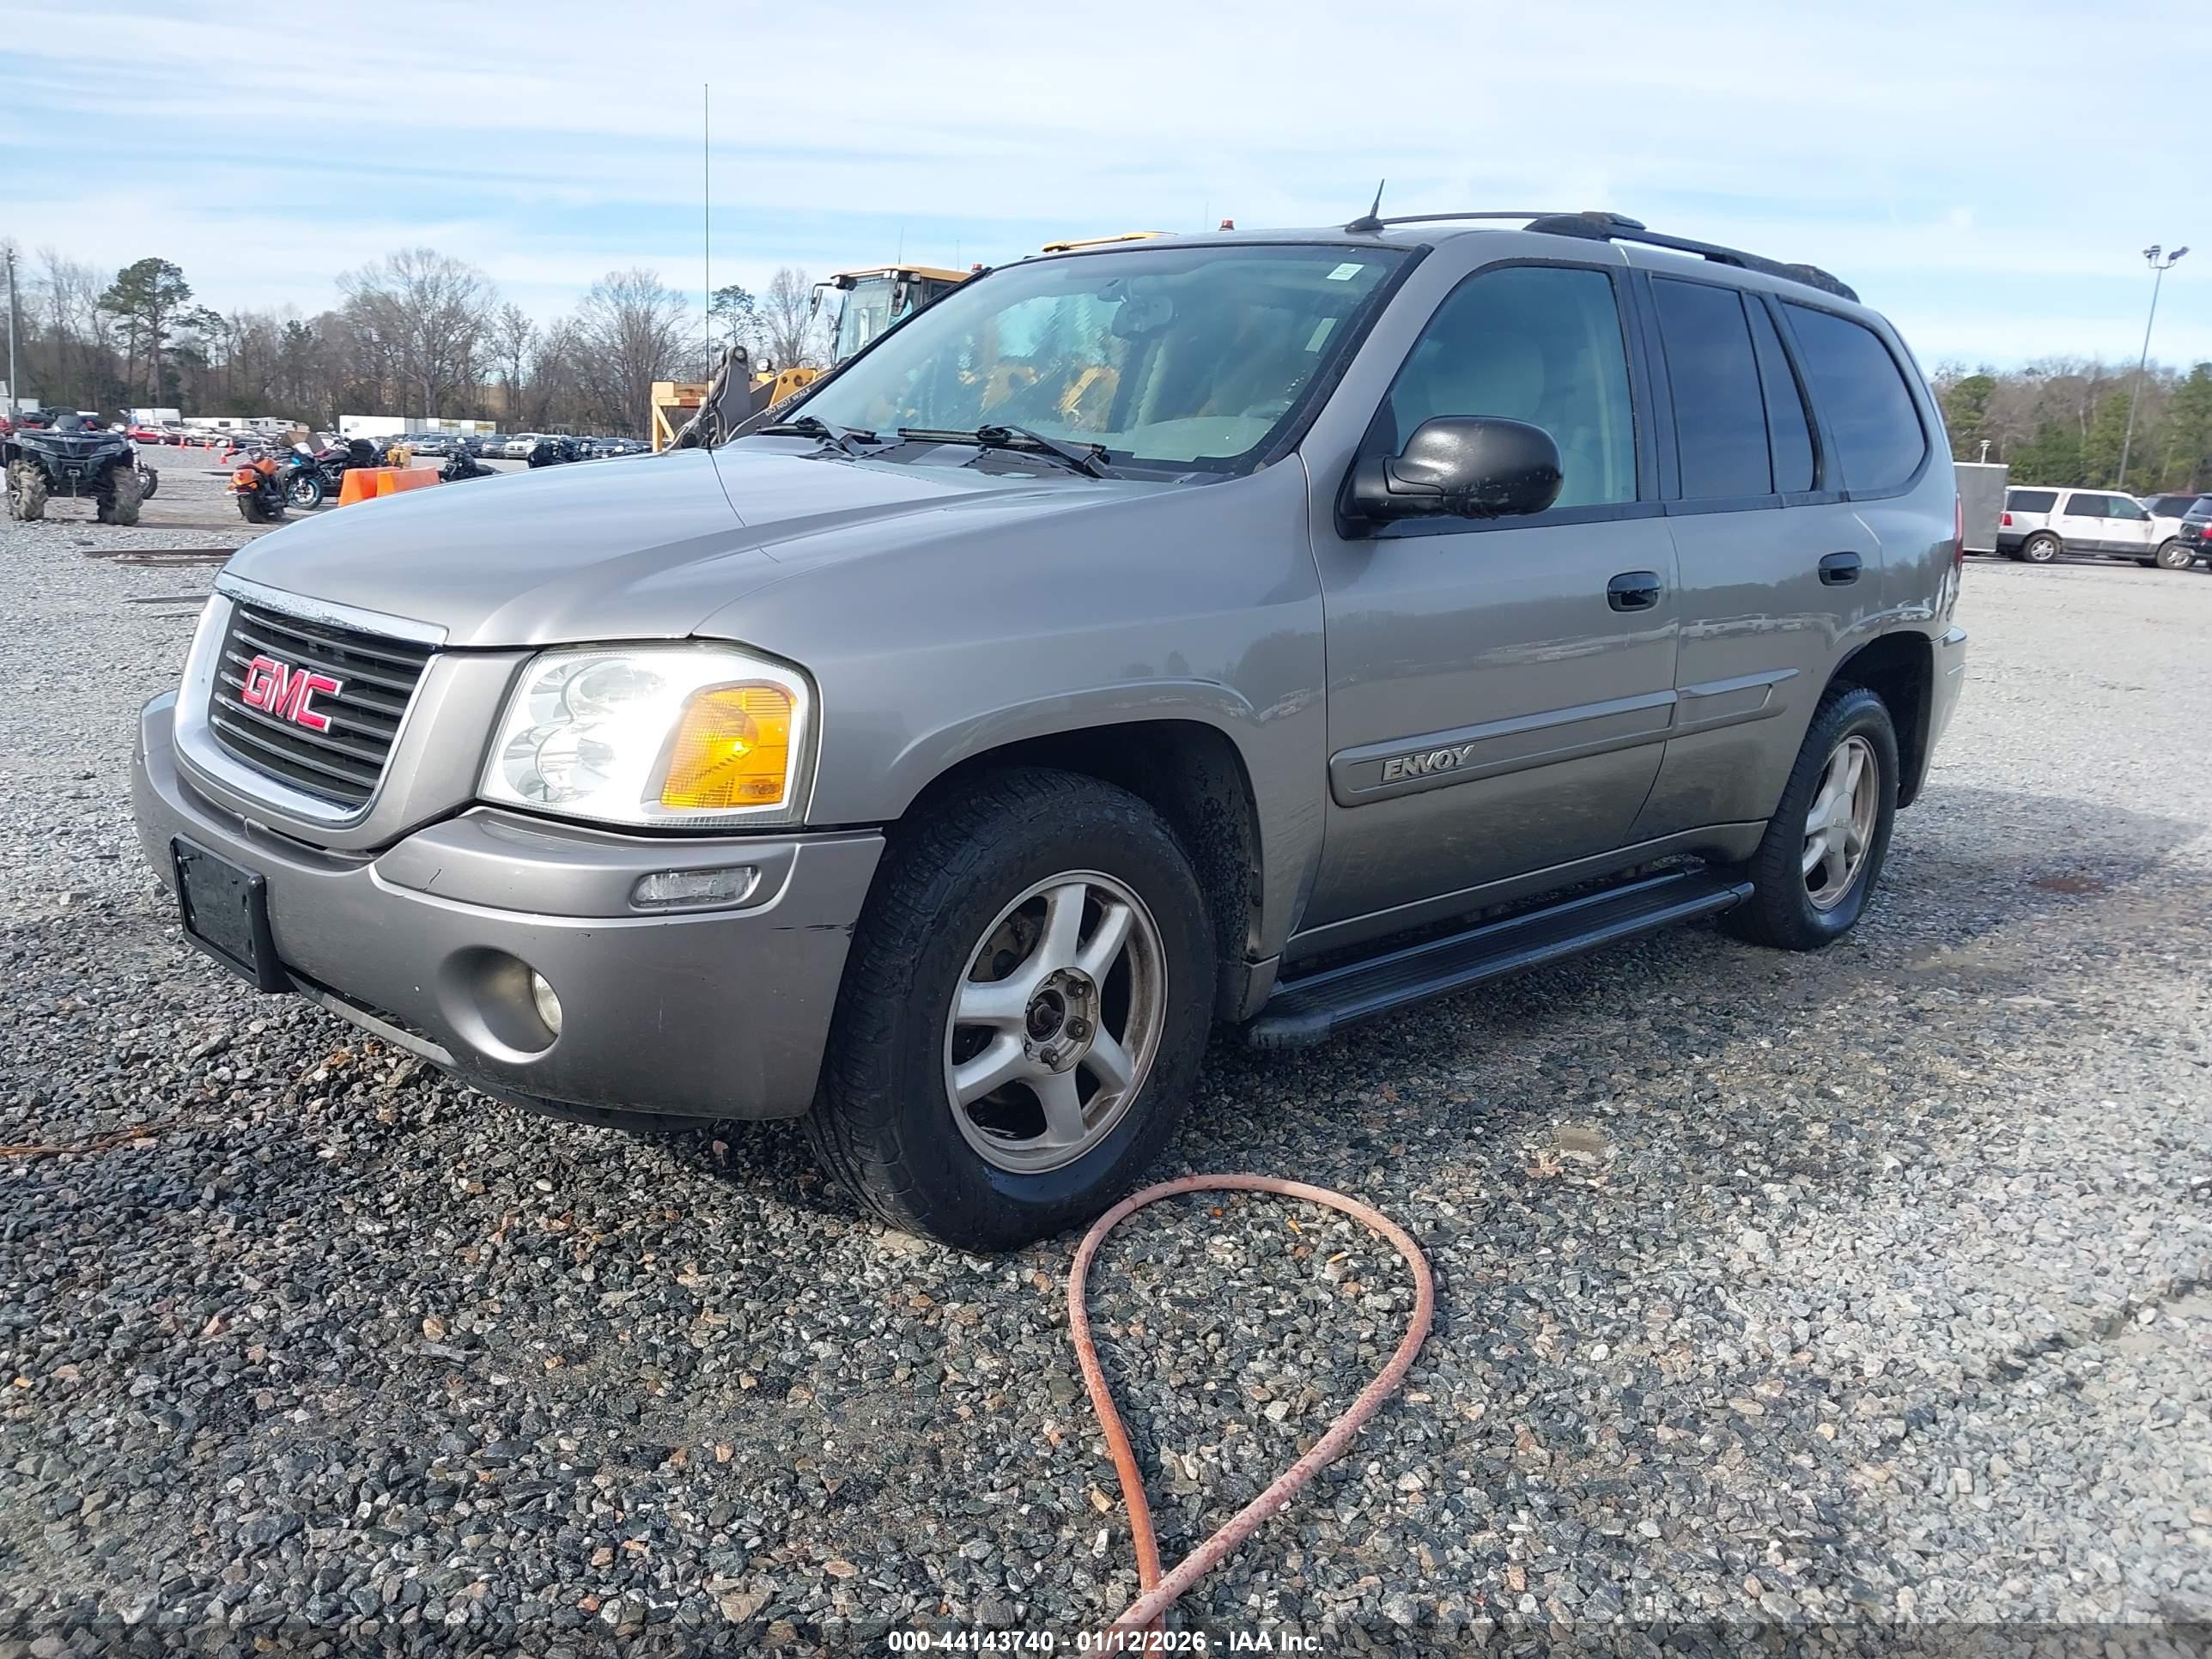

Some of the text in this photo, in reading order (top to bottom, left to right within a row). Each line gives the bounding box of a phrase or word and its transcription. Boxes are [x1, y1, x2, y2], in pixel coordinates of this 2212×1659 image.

[764, 405, 776, 416] DO
[776, 397, 792, 410] NOT
[791, 386, 812, 401] WALK
[242, 654, 343, 734] GMC
[1382, 744, 1475, 781] ENVOY
